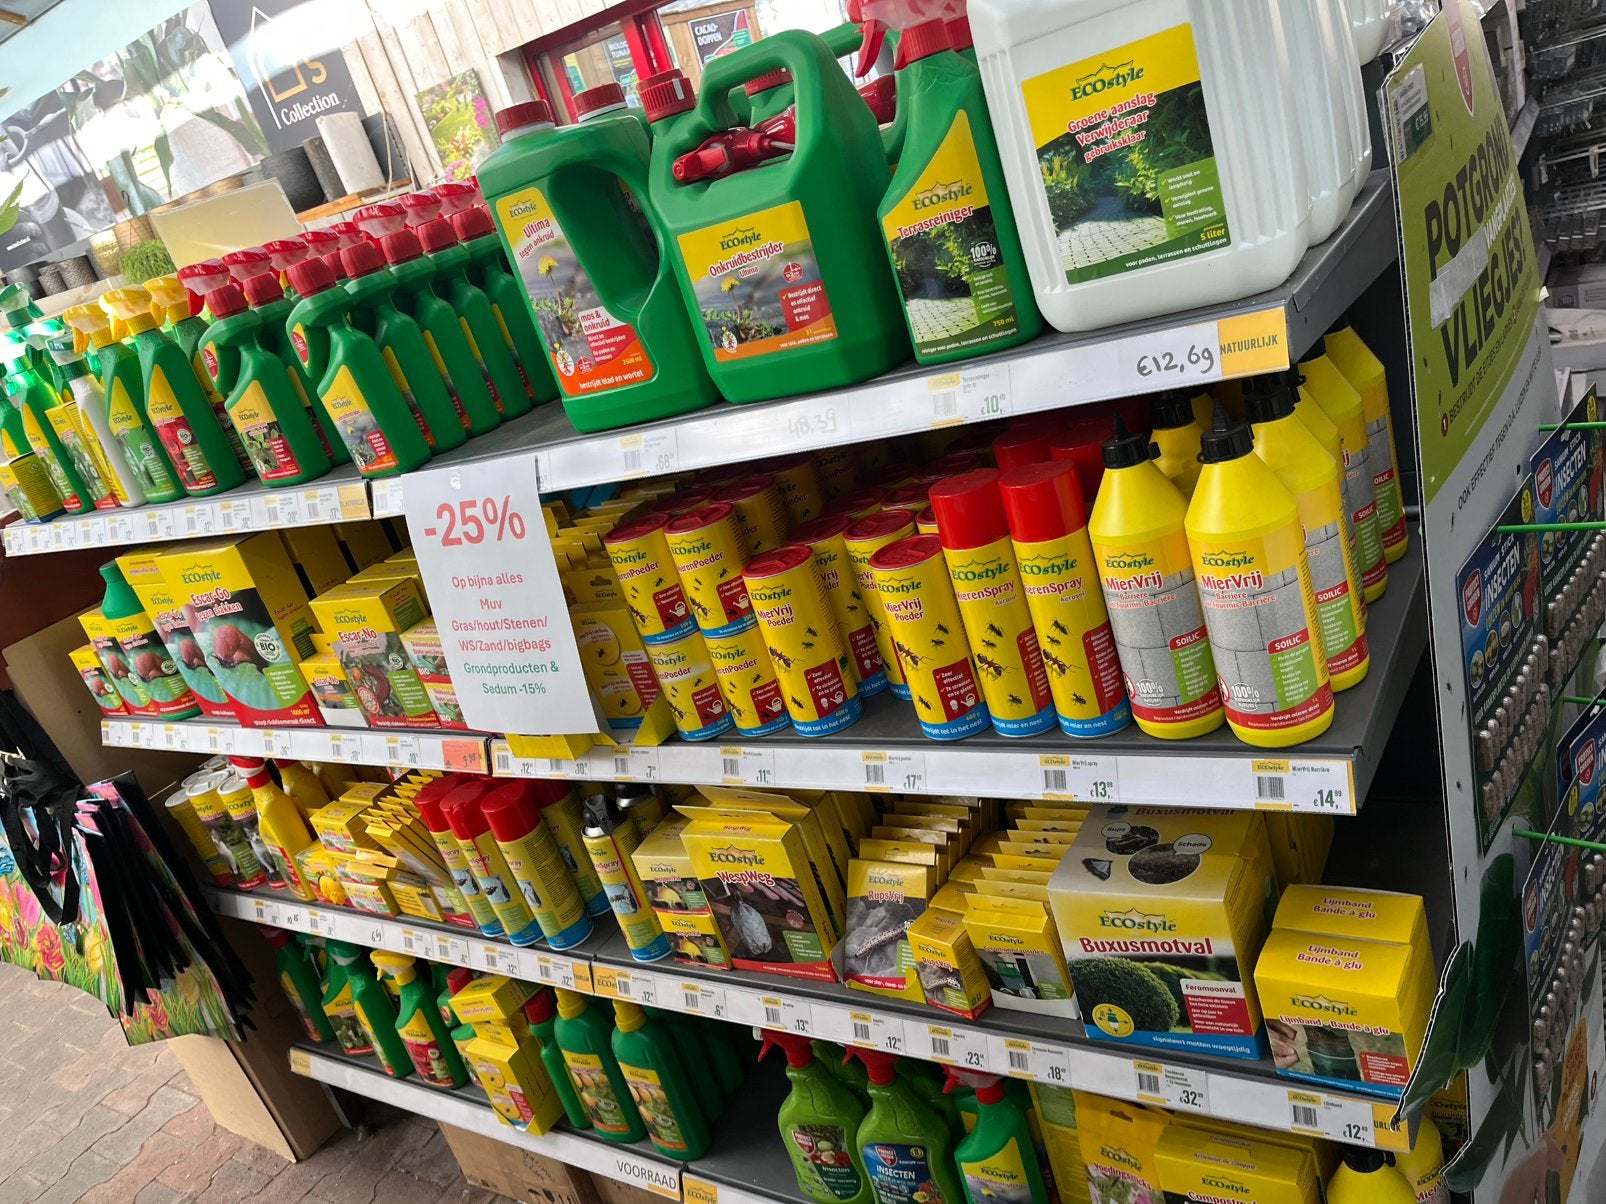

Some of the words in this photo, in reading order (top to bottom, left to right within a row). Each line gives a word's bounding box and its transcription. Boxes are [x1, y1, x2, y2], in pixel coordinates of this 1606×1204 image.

[1071, 67, 1144, 101] ECOstyle
[280, 92, 340, 126] Collection
[1067, 108, 1108, 134] Groene
[1111, 91, 1156, 117] aanslag
[1076, 111, 1149, 147] Verwijderaar
[1084, 130, 1146, 164] gebruiksklaar
[912, 184, 976, 211] ECOstyle
[1196, 185, 1214, 196] groene
[1424, 112, 1511, 282] POTGROND
[510, 203, 537, 219] ECOstyle
[1172, 200, 1192, 210] aanslag
[897, 205, 974, 239] Terrasreiniger
[1175, 213, 1186, 221] Voor
[1193, 211, 1217, 223] houtwerk
[523, 218, 551, 239] Ultima
[1201, 232, 1206, 241] 5
[1207, 228, 1226, 240] liter
[519, 241, 535, 259] tegen
[533, 229, 555, 249] onkruid
[720, 232, 761, 252] ECOstyle
[970, 243, 997, 259] 100%
[1126, 260, 1138, 268] voor
[1138, 255, 1157, 266] paden,
[1157, 248, 1183, 261] terrassen
[1191, 237, 1227, 252] schuttingen
[709, 241, 784, 277] Onkruidbestrijder
[739, 265, 759, 279] Ultima
[787, 288, 807, 299] Bestrijdt
[807, 284, 822, 294] direct
[1440, 209, 1528, 389] VLIEGJES?
[580, 313, 595, 323] mos
[595, 310, 602, 319] &
[792, 305, 811, 315] onkruid
[584, 318, 611, 332] onkruid
[993, 318, 1005, 327] 750
[1005, 316, 1014, 324] ml
[988, 328, 1017, 340] schuttingen
[1220, 334, 1278, 356] NATUURLIJK
[580, 377, 602, 390] bestrijdt
[602, 376, 615, 385] blad
[615, 374, 623, 383] en
[623, 370, 644, 381] wortel
[1449, 379, 1476, 424] BESTRIJDT
[1554, 439, 1587, 498] INSECTEN
[1457, 486, 1471, 511] OOK
[1470, 444, 1496, 492] EFFECTIEF
[1358, 504, 1374, 519] SOILIC
[424, 495, 527, 547] -25%
[1020, 559, 1078, 577] ECOstyle
[1105, 556, 1155, 569] ECOstyle
[1202, 555, 1255, 568] ECOstyle
[952, 563, 1011, 582] ECOstyle
[1482, 558, 1499, 582] SANIUM
[181, 572, 221, 584] ECOstyle
[451, 576, 466, 589] Op
[466, 574, 494, 589] bijna
[495, 573, 523, 584] alles
[1104, 571, 1163, 592] MierVrij
[1201, 571, 1263, 593] MierVrij
[1484, 549, 1521, 612] INSECTEN
[752, 587, 793, 600] ECOstyle
[878, 580, 922, 594] ECOstyle
[1317, 586, 1342, 602] SOILIC
[1464, 574, 1481, 599] PROTECT
[190, 588, 231, 607] Escar-Go
[480, 599, 503, 611] Muv
[995, 594, 1018, 607] Aerosol
[1060, 592, 1086, 604] Aerosol
[195, 608, 213, 622] tegen
[213, 601, 243, 617] slakken
[757, 604, 794, 621] MierVrij
[884, 598, 922, 613] MierVrij
[334, 614, 368, 626] ECOstyle
[451, 616, 548, 632] Gras/hout/Stenen/
[767, 615, 795, 628] Poeder
[895, 611, 924, 622] Poeder
[338, 628, 377, 644] Escar-No
[1175, 632, 1200, 647] SOILIC
[1274, 636, 1302, 651] SOILIC
[259, 642, 275, 652] BIO
[458, 639, 552, 654] WS/Zand/bigbags
[463, 662, 548, 676] Grondproducten
[550, 661, 559, 672] &
[811, 671, 821, 679] Zeer
[941, 671, 953, 680] Zeer
[313, 676, 340, 686] Escar-No
[482, 682, 517, 694] Sedum
[519, 682, 547, 694] -15%
[960, 683, 974, 694] gieten
[1136, 681, 1164, 695] 100%
[1231, 684, 1261, 699] 100%
[828, 719, 838, 727] het
[839, 714, 851, 725] nest
[1007, 721, 1020, 729] mier
[1027, 718, 1043, 727] nest
[1270, 713, 1291, 723] Verdrijft
[1291, 709, 1308, 718] mieren
[950, 725, 957, 733] in
[957, 722, 968, 731] het
[968, 718, 983, 729] nest
[1070, 721, 1083, 729] mier
[1091, 719, 1107, 727] nest
[1044, 758, 1067, 766] ECOstyle
[1577, 742, 1595, 767] PROTECT
[1257, 763, 1285, 772] ECOstyle
[1090, 781, 1107, 799] €13
[1313, 788, 1335, 808] €14
[1106, 826, 1127, 834] Rups
[1177, 840, 1208, 849] Schade
[709, 852, 766, 867] ECOstyle
[650, 866, 677, 874] ECOstyle
[717, 870, 775, 888] WespWeg
[869, 874, 905, 888] ECOstyle
[868, 890, 904, 905] RupsVrij
[1323, 897, 1373, 909] Lijmband
[1313, 905, 1347, 917] Bande
[1358, 910, 1376, 920] glu
[671, 920, 697, 929] ECOstyle
[1099, 916, 1178, 933] ECOstyle
[989, 935, 1025, 946] ECOstyle
[1078, 937, 1214, 956] Buxusmotval
[918, 943, 947, 958] ECOstyle
[1308, 944, 1360, 959] Lijmband
[922, 956, 953, 972] RupsVrij
[1297, 952, 1332, 967] Bande
[1334, 958, 1341, 967] à
[1343, 960, 1363, 971] glu
[1185, 983, 1238, 995] Feromoonval
[1291, 997, 1358, 1017] ECOstyle
[1279, 1014, 1323, 1028] Lijmband
[1330, 1019, 1362, 1033] Bande
[1364, 1024, 1371, 1034] à
[1373, 1026, 1390, 1037] glu
[1152, 1036, 1186, 1048] signaleert
[1186, 1040, 1211, 1050] motten
[1211, 1043, 1251, 1056] vroegtijdig
[965, 1051, 981, 1066] €23
[1048, 1065, 1062, 1081] €18
[1179, 1089, 1198, 1106] €32
[1343, 1123, 1361, 1140] €12
[1100, 1148, 1143, 1173] ECOstyle
[616, 1159, 678, 1190] VOORRAAD
[822, 1165, 851, 1174] Insecten
[876, 1165, 916, 1181] INSECTEN
[980, 1166, 1019, 1180] ECOstyle
[1093, 1162, 1152, 1191] Voedingssticks
[1201, 1176, 1251, 1194] ECOstyle
